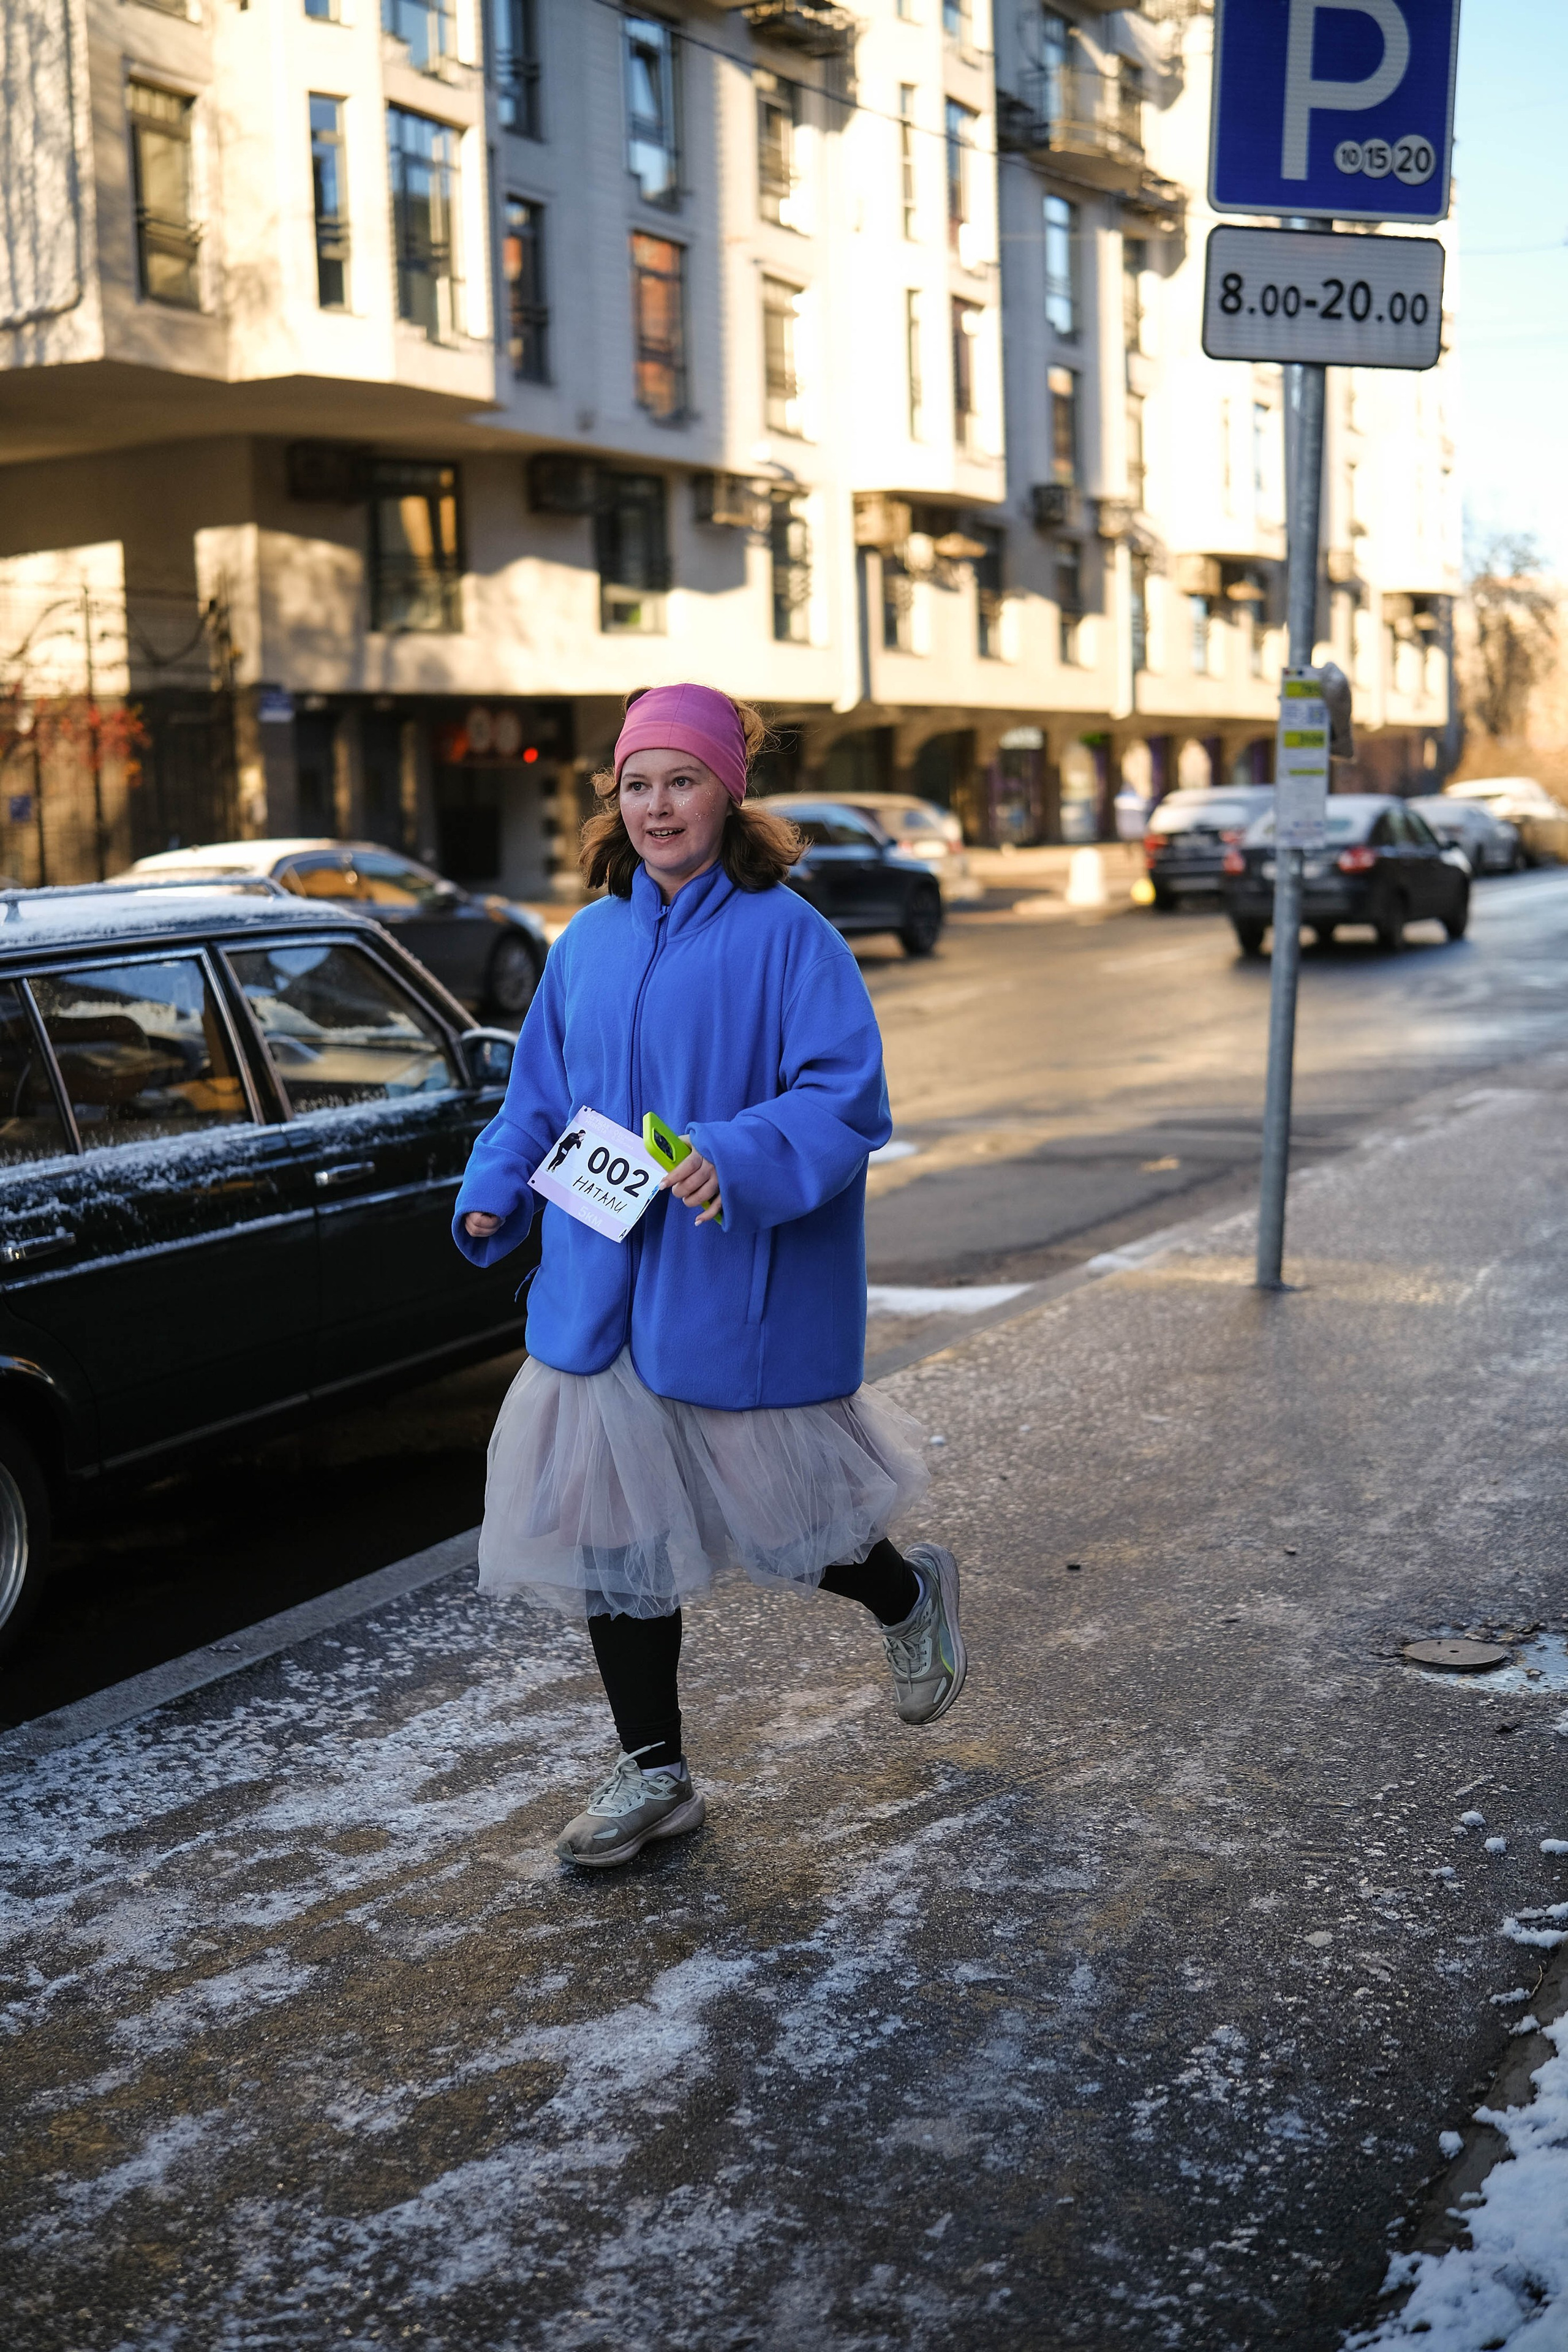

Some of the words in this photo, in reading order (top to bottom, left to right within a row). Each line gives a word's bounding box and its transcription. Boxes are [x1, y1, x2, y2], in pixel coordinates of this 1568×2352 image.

[1281, 0, 1410, 181] P
[1341, 149, 1359, 165] 10
[1368, 147, 1387, 169] 15
[1398, 146, 1431, 173] 20
[1219, 273, 1429, 327] 8.00-20.00
[572, 1175, 628, 1214] НАТАЛИ
[587, 1147, 649, 1198] 002
